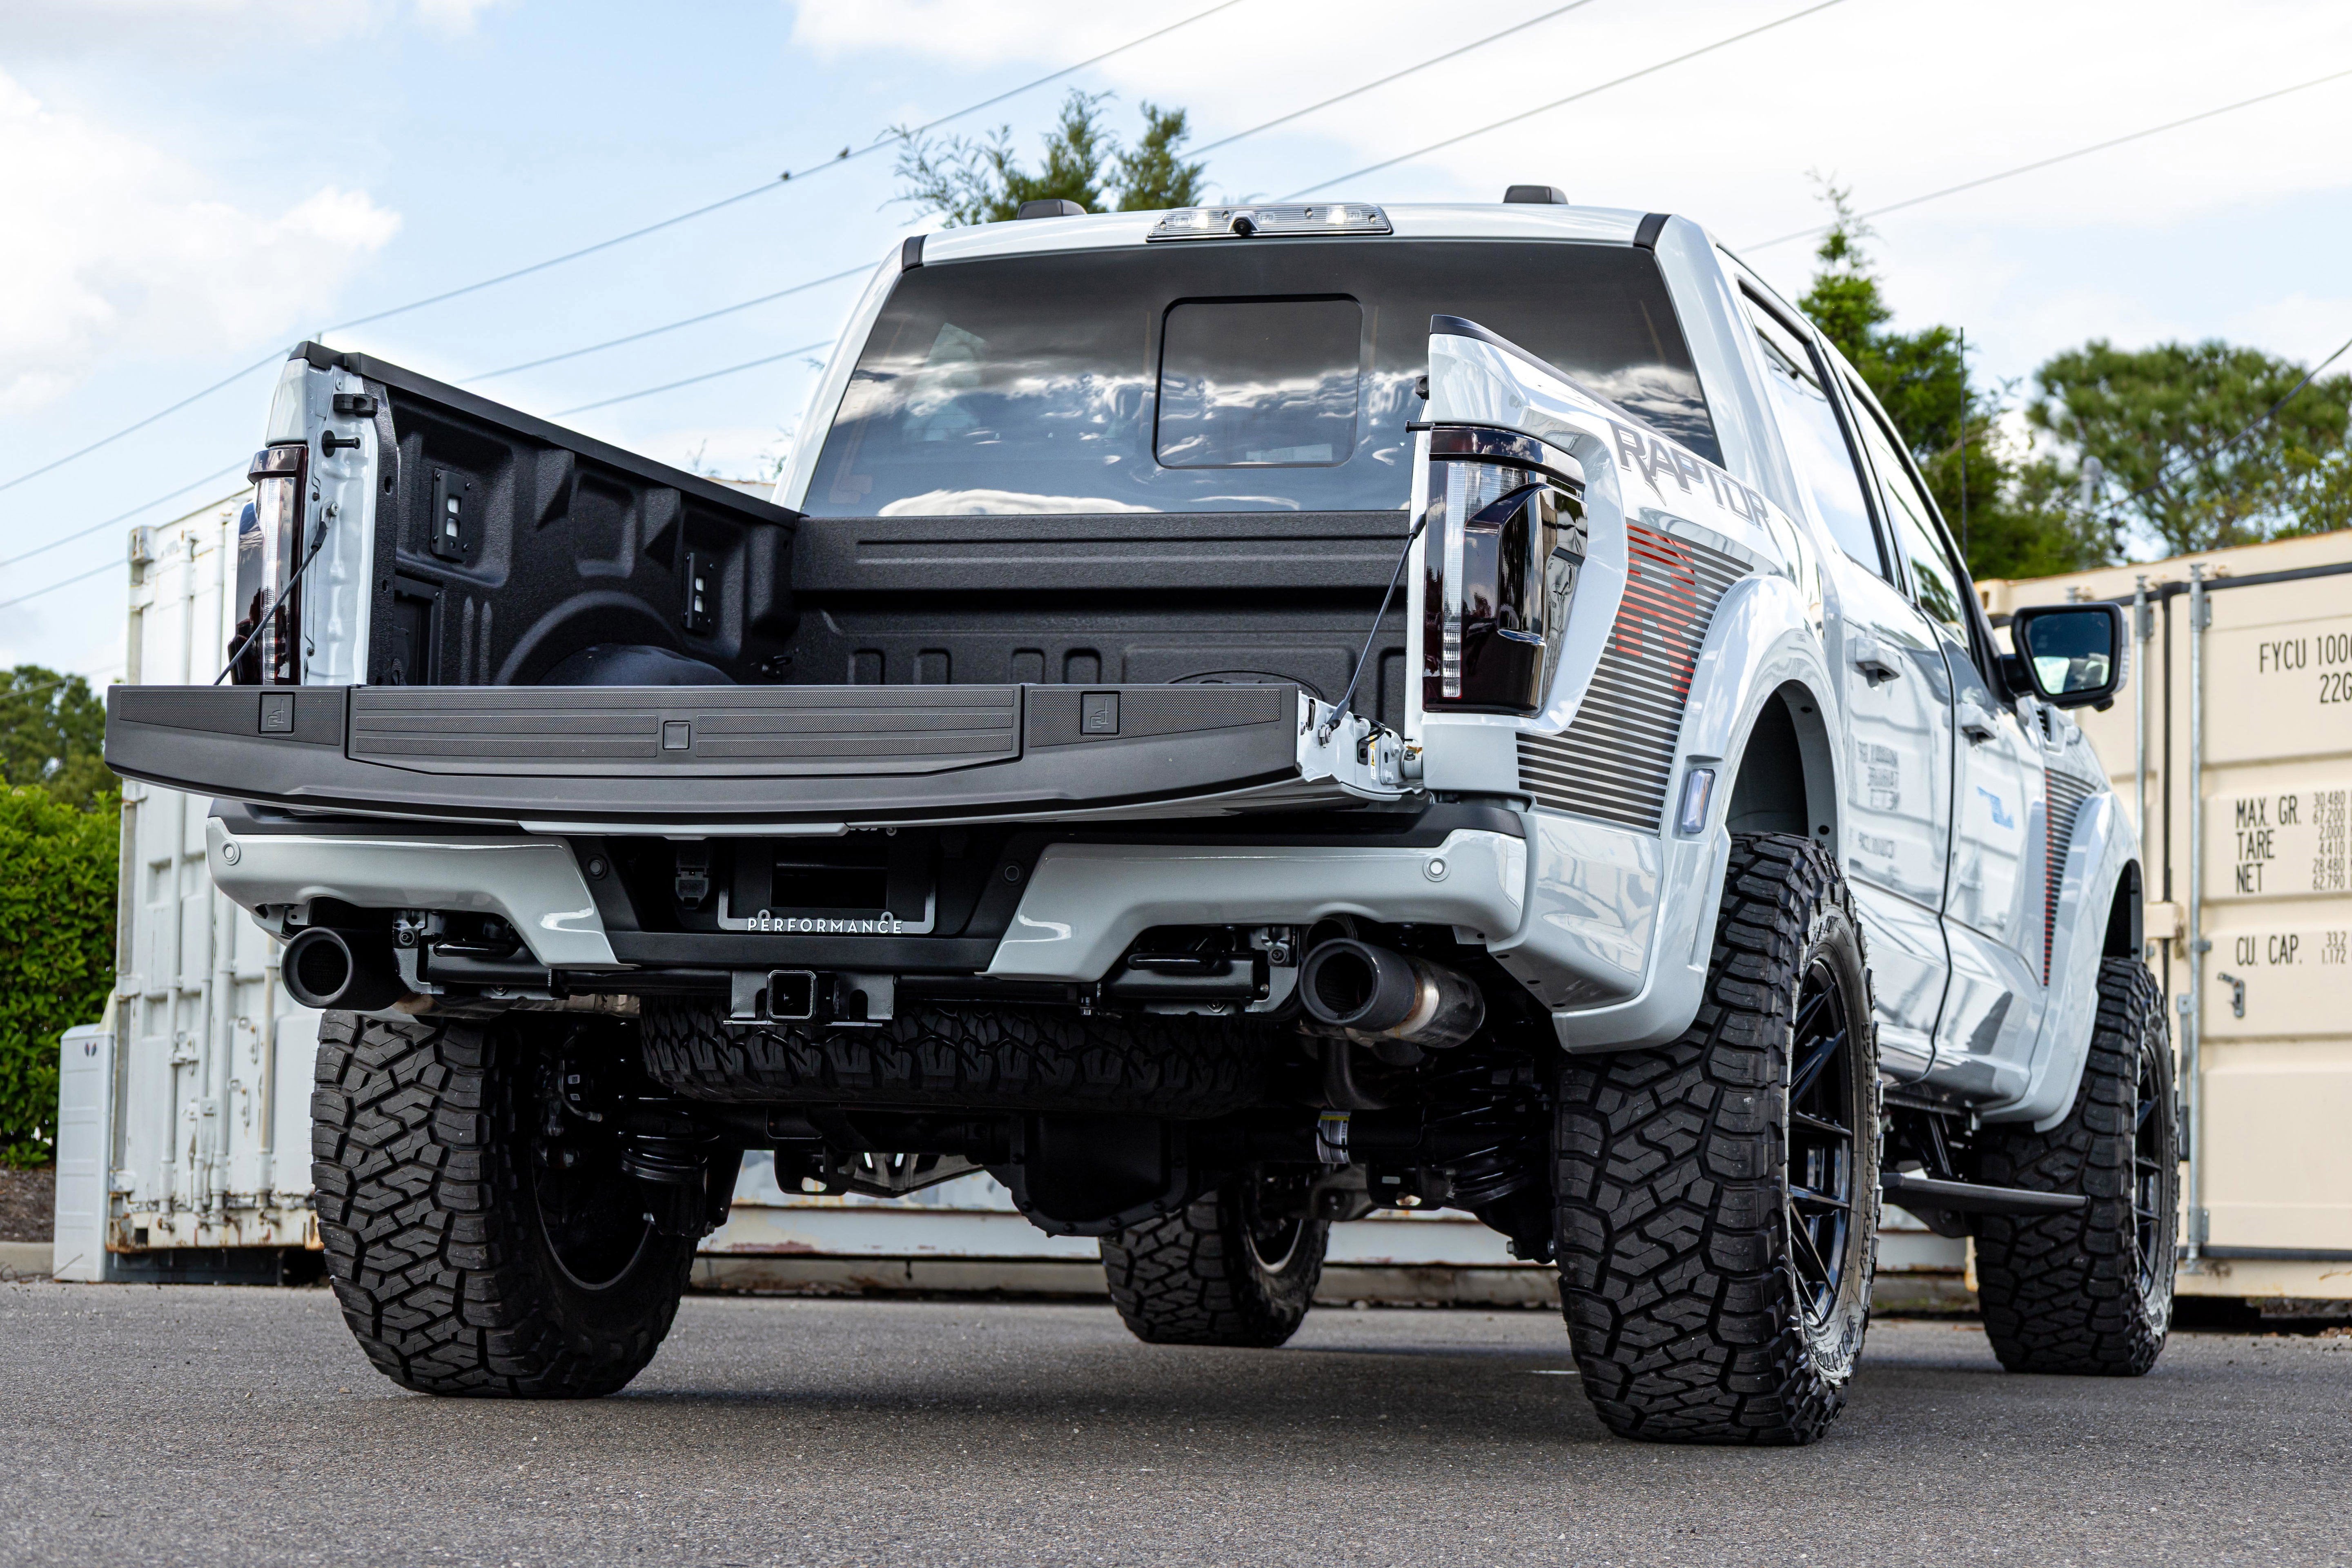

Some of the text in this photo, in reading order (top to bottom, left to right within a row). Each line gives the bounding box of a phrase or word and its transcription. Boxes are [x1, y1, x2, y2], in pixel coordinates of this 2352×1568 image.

[1606, 418, 1785, 564] RAPTOR
[2259, 633, 2352, 673] FYCU 100
[2236, 797, 2270, 828] MAX.
[2278, 793, 2301, 825] GR.
[2236, 829, 2275, 860] TARE
[2236, 863, 2263, 893] NET
[747, 917, 902, 934] PERFORMANCE
[2268, 933, 2303, 964] CAP.
